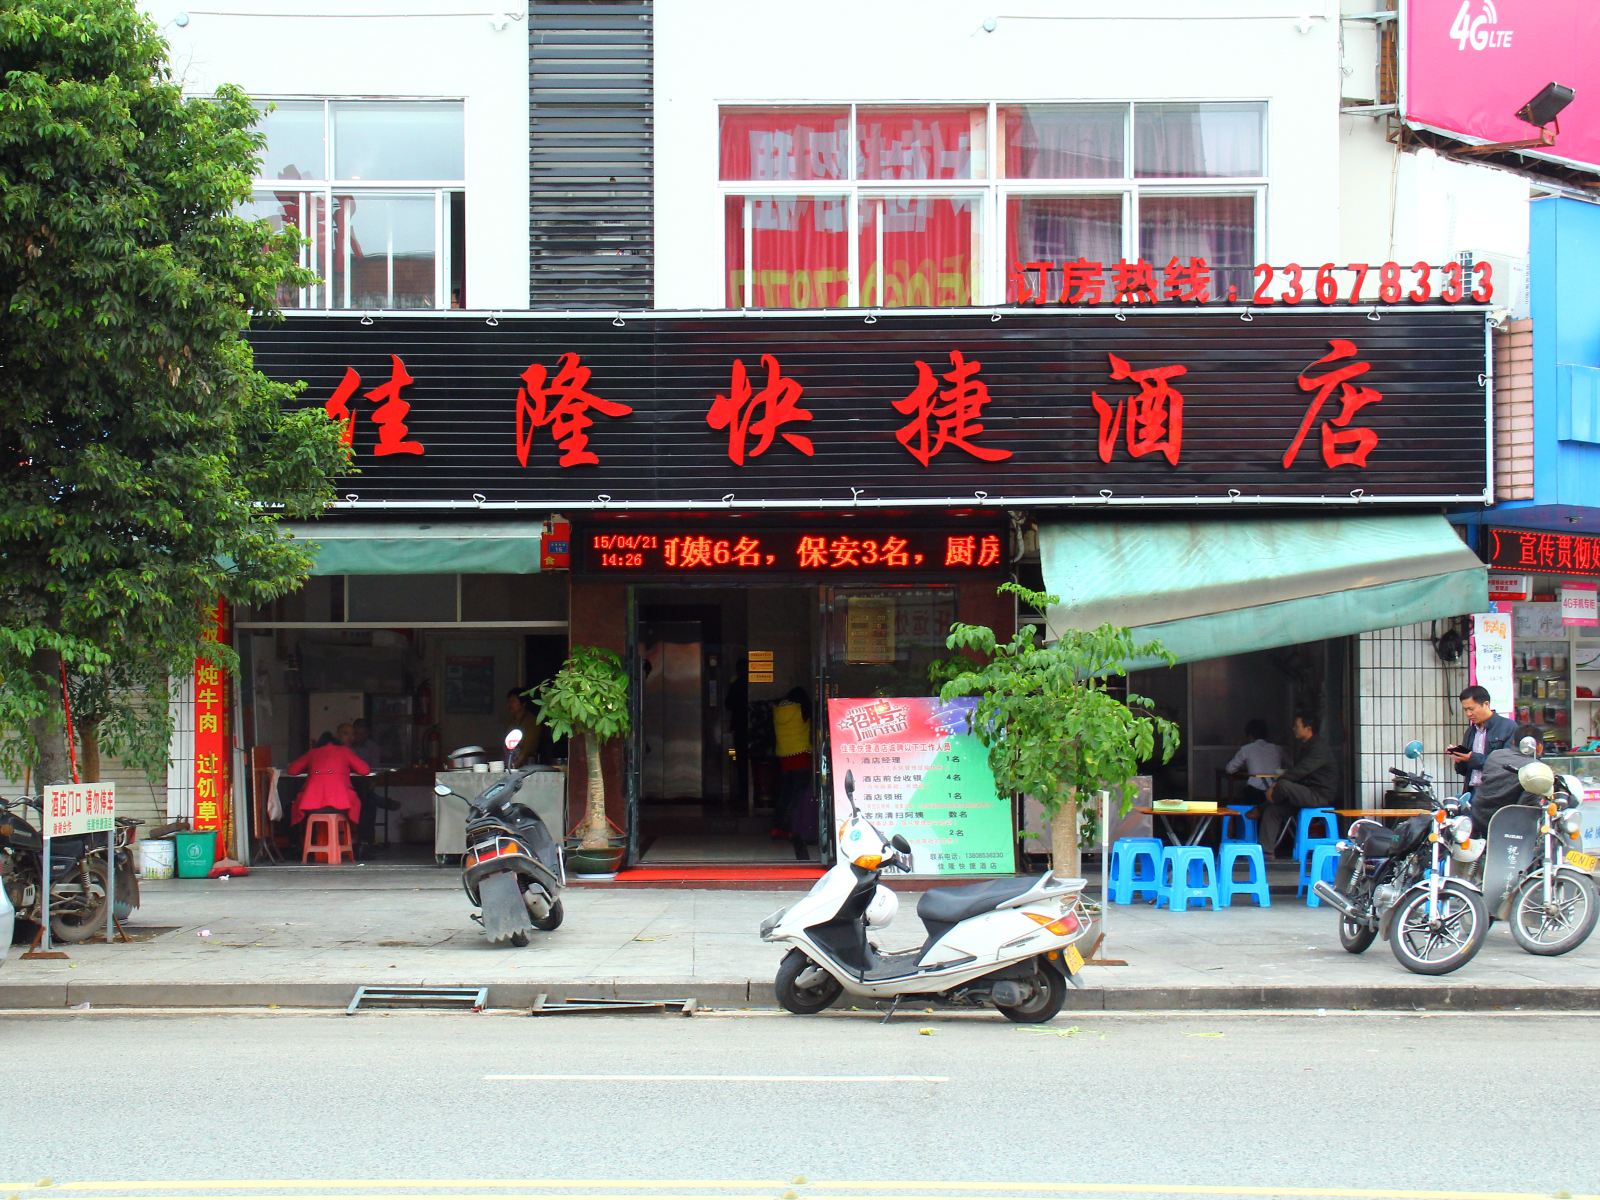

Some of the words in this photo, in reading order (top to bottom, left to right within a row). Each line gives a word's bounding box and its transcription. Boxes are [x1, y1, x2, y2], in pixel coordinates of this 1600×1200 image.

[325, 339, 1384, 474] 佳隆快捷酒店
[593, 535, 657, 549] 15/04/21
[602, 554, 642, 566] 14:26
[198, 665, 219, 733] 炖牛肉
[51, 791, 82, 817] 酒店门口
[86, 788, 113, 815] 请勿停车
[197, 754, 218, 831] 过饥草
